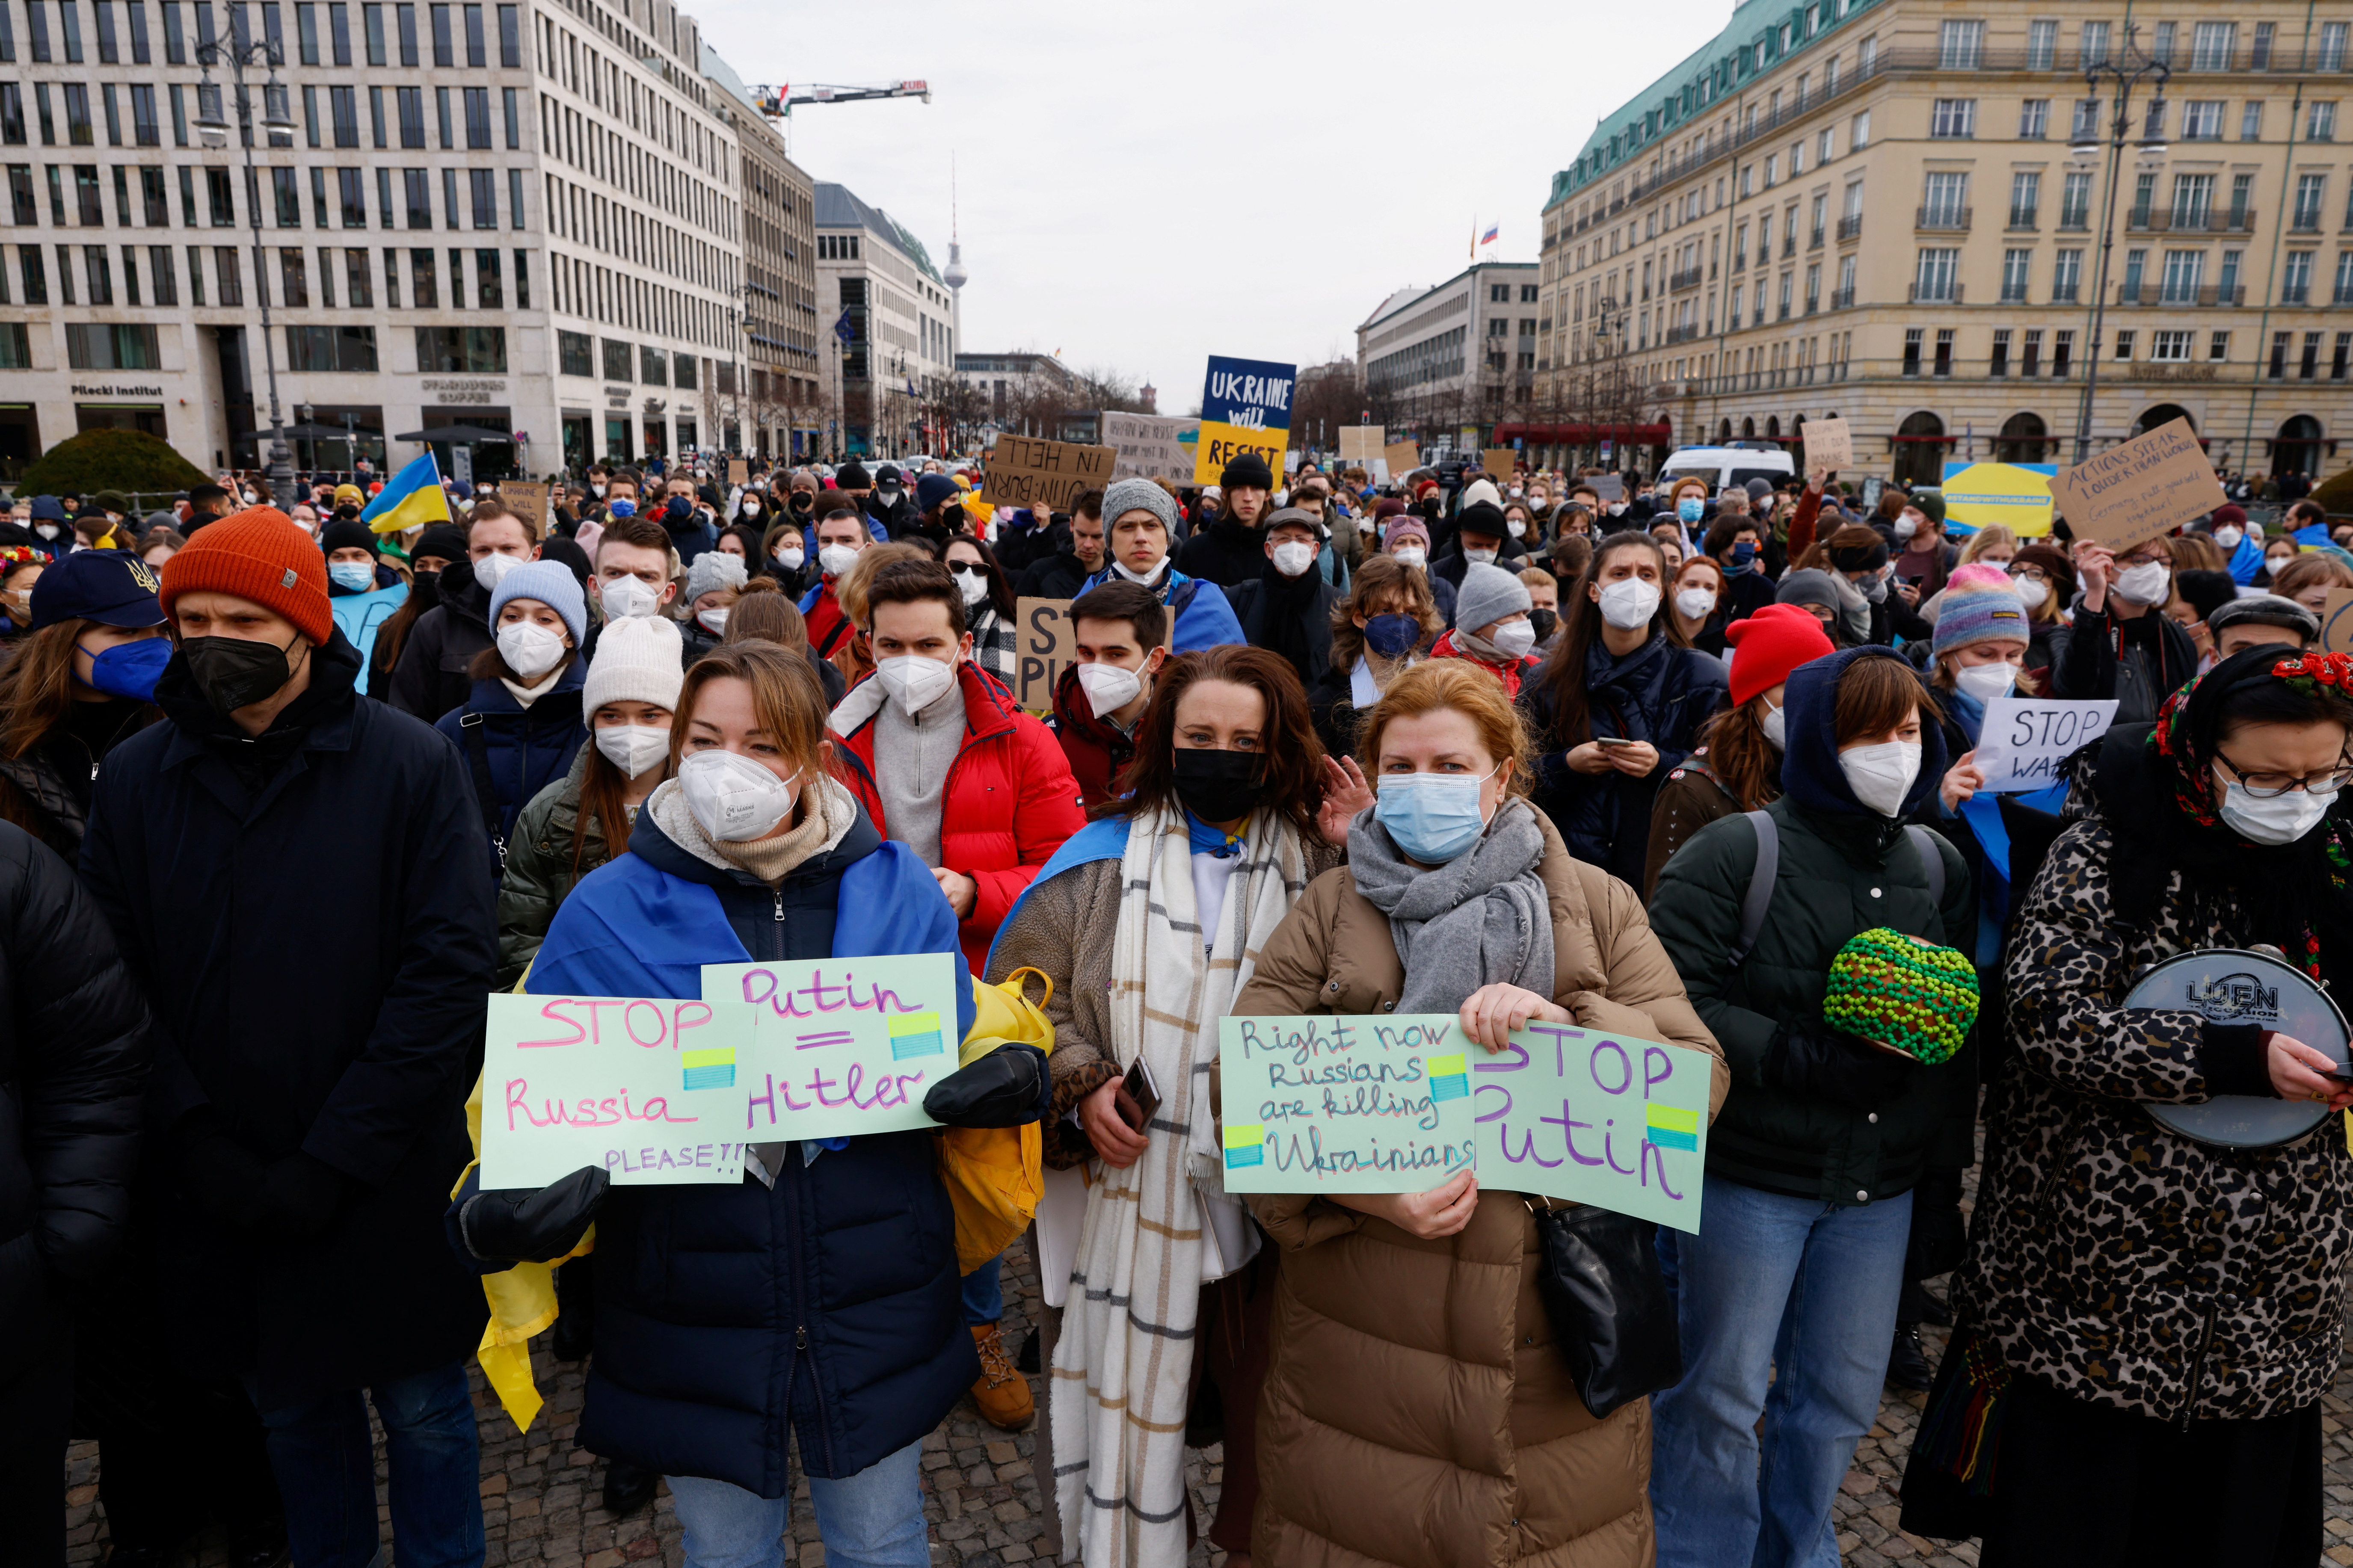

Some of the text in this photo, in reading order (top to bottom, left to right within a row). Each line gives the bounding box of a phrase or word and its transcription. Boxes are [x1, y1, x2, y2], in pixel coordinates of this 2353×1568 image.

[71, 385, 163, 396] Pilecki Institut
[1212, 371, 1292, 410] UKRAINE
[1004, 438, 1101, 473] IN HELL
[2069, 430, 2179, 491] ACTIONS SPEAK
[2081, 439, 2195, 500] LOUDER THAN WORDS
[504, 487, 536, 497] UKRAINE
[512, 500, 532, 509] WILL
[982, 470, 1102, 509] UTIN: BURN
[1946, 495, 2048, 504] #STANDWITHUKRAINE
[2127, 530, 2137, 540] up
[2012, 711, 2100, 747] STOP
[2187, 980, 2278, 1011] LUEN
[517, 999, 713, 1050] STOP
[1241, 1017, 1452, 1065] Right now
[1269, 1056, 1423, 1088] Russians
[506, 1078, 698, 1131] Russia
[747, 1062, 925, 1130] Hitler
[1259, 1082, 1439, 1131] are killing
[1266, 1124, 1474, 1180] Ukrainians
